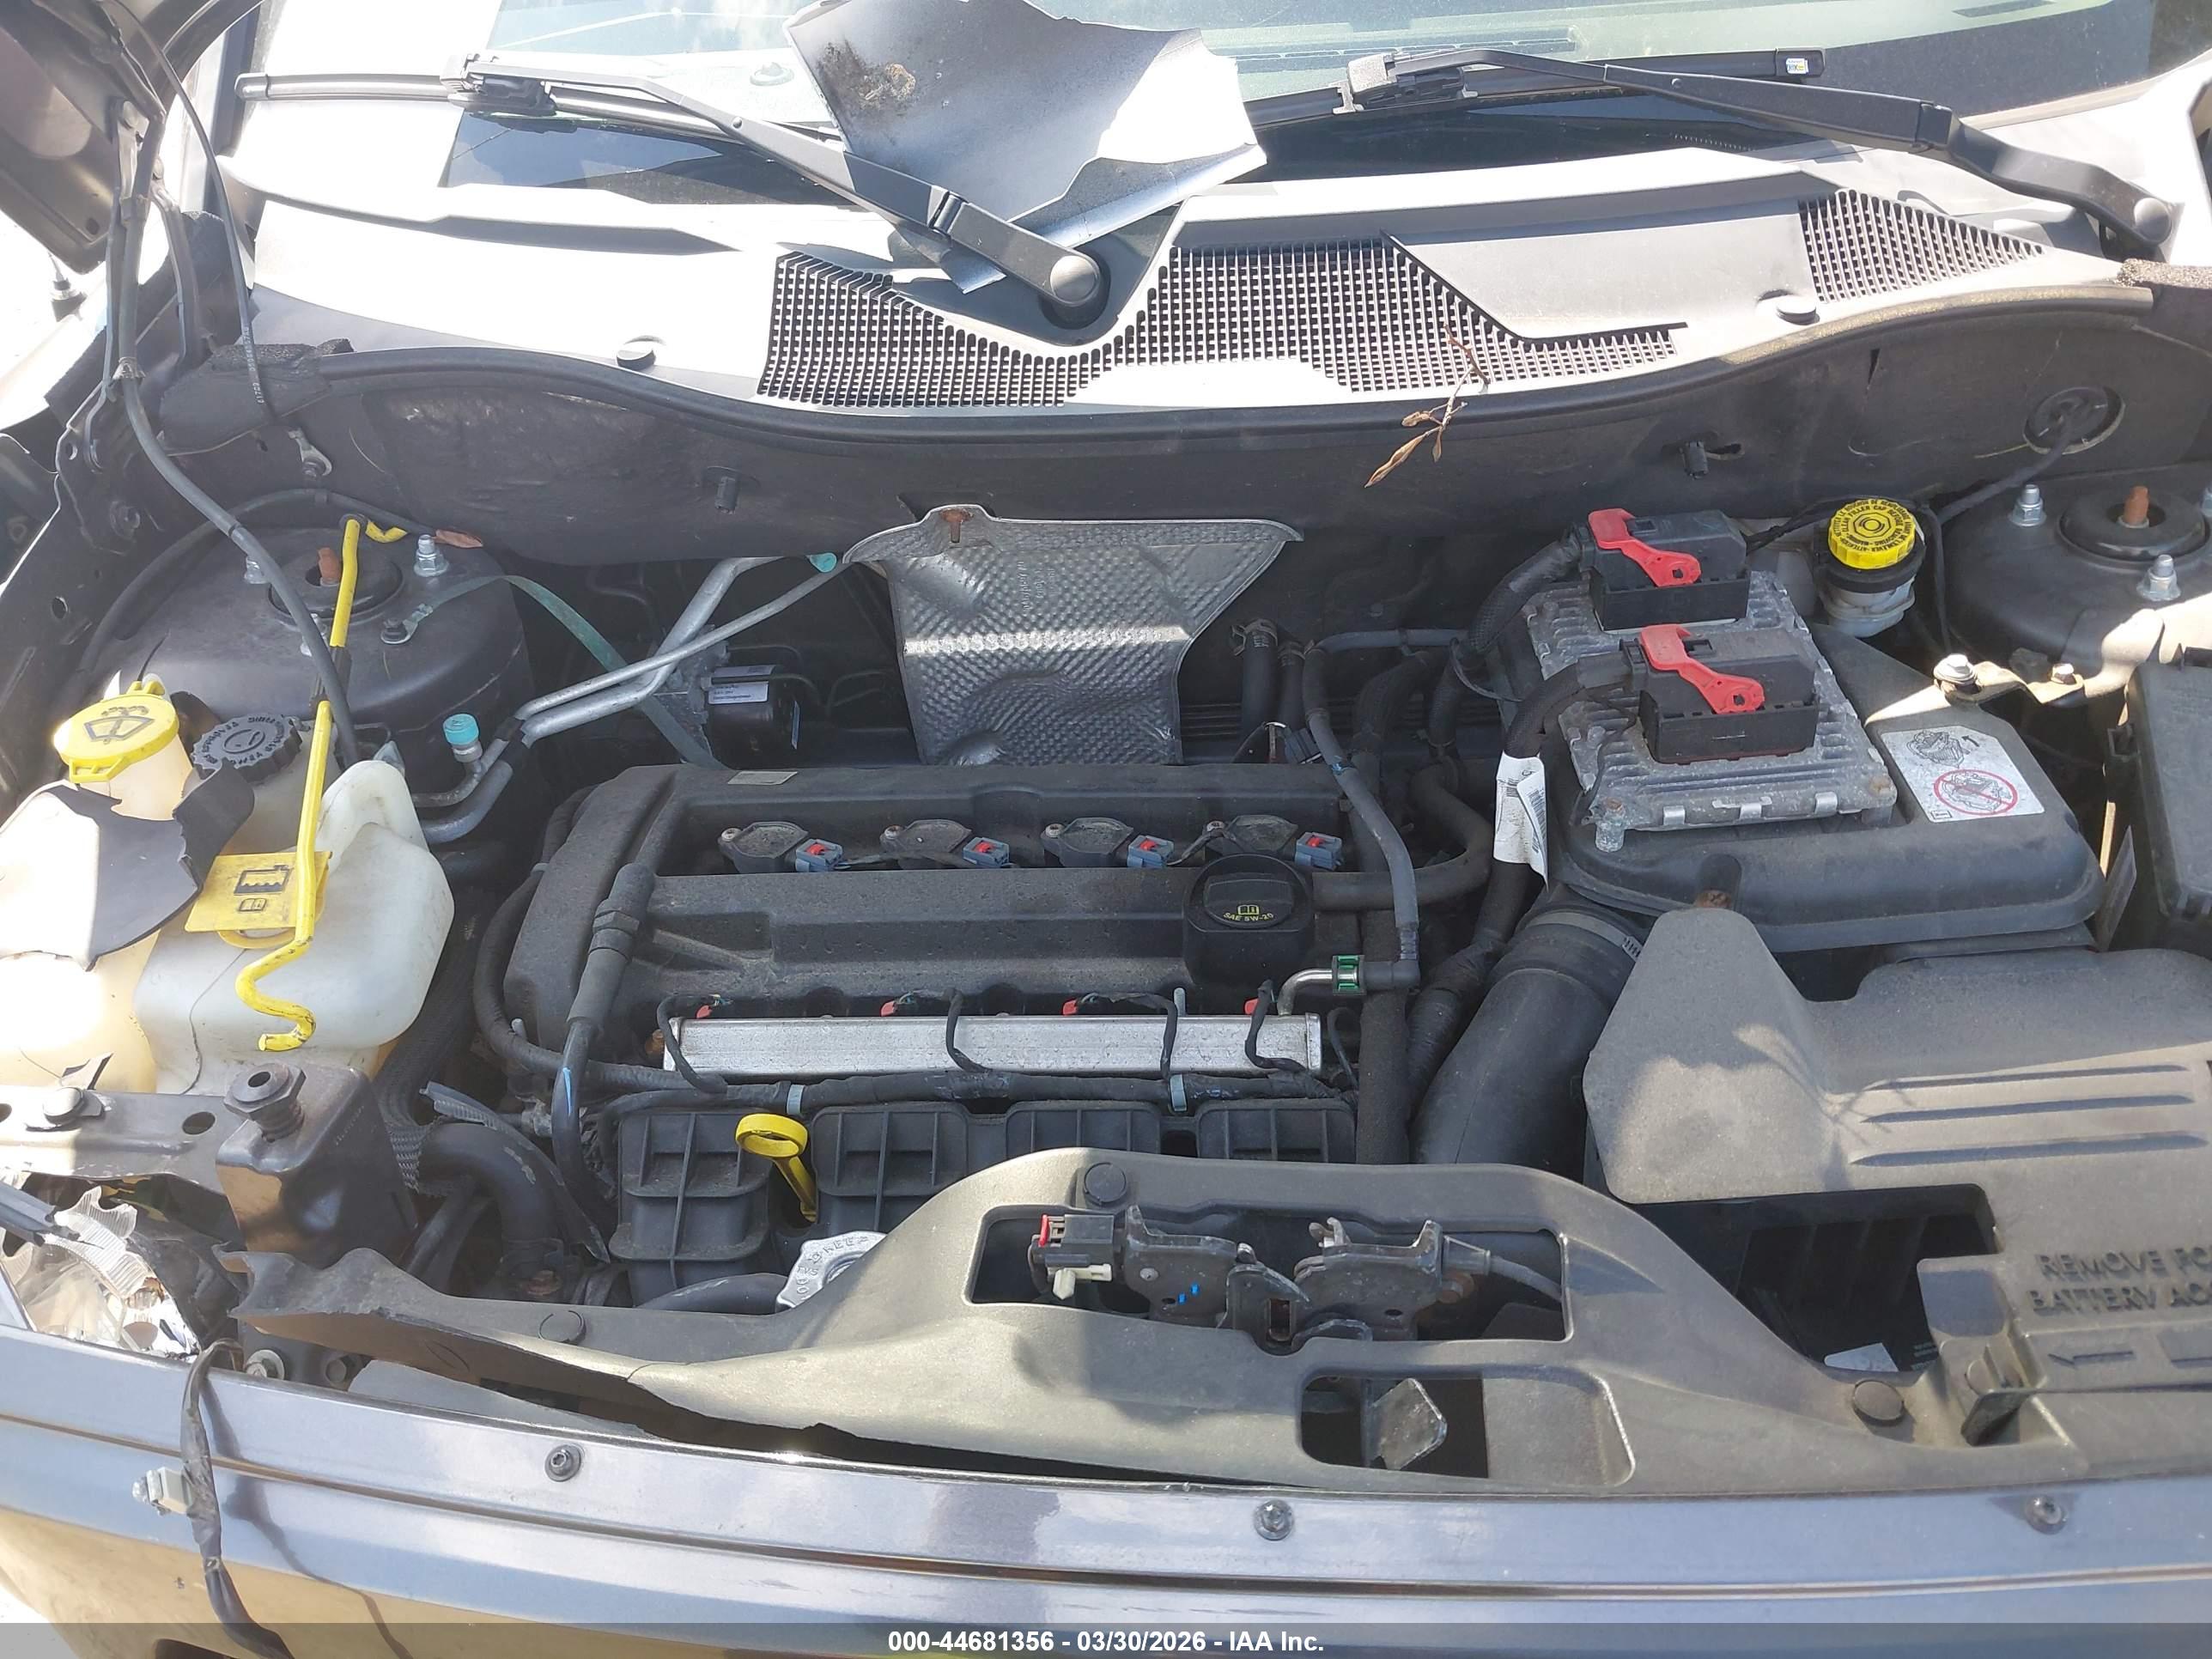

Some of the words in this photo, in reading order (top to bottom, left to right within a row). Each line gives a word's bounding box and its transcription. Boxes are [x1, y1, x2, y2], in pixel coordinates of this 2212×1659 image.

[1848, 505, 1871, 518] FILLER
[1223, 912, 1242, 922] SAE
[1244, 913, 1274, 922] 5W-20
[2035, 1250, 2168, 1281] REMOVE
[2027, 1286, 2156, 1316] BATTERY
